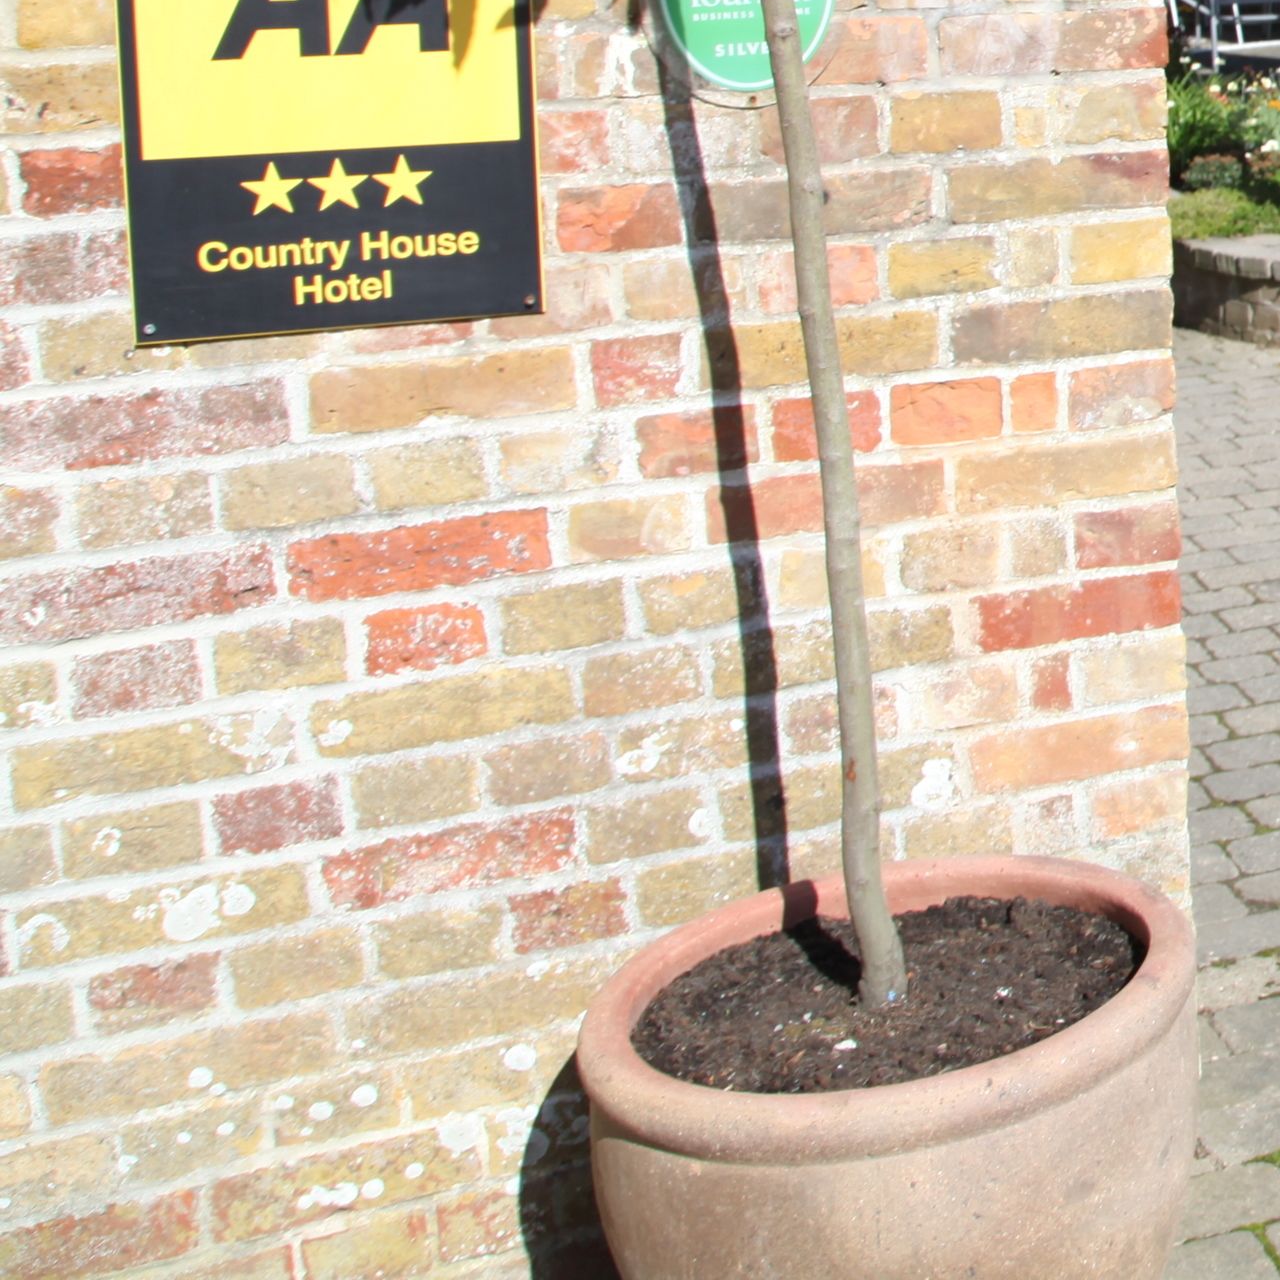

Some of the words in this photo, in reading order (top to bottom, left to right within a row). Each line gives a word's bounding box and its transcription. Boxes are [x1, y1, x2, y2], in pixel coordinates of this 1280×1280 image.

[692, 10, 755, 22] BUSINESS
[715, 41, 770, 57] SILVE
[198, 237, 351, 272] Country
[361, 229, 480, 261] House
[294, 269, 392, 305] Hotel
